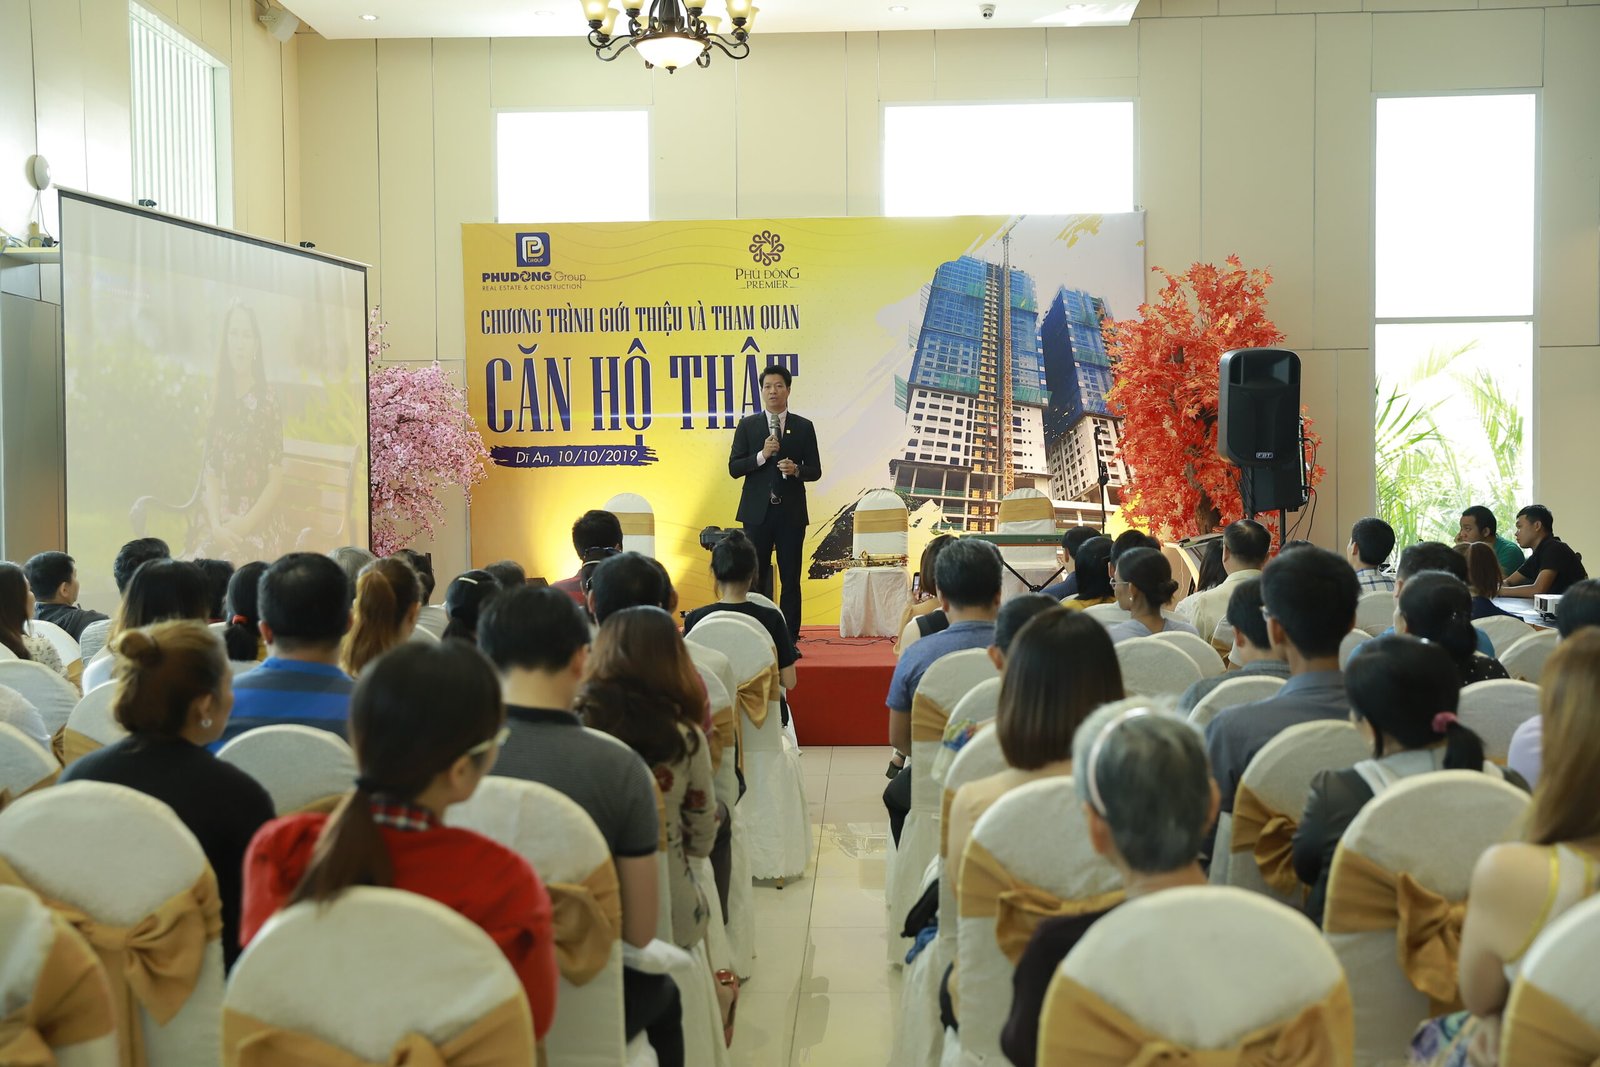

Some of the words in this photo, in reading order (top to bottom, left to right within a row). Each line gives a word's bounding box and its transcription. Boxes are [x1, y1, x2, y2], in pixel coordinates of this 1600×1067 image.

[554, 271, 587, 287] Group
[746, 280, 788, 289] PREMIER
[481, 308, 542, 334] CHƯƠNG
[547, 302, 594, 333] TRÌNH
[600, 301, 630, 332] GIỚI
[635, 300, 682, 336] THIỆU
[688, 300, 706, 331] VÀ
[711, 305, 755, 331] THAM
[760, 304, 800, 332] QUAN
[486, 344, 572, 433] CĂN
[590, 338, 652, 446] HỘ
[532, 451, 553, 465] An,
[558, 449, 638, 464] 10/10/2019
